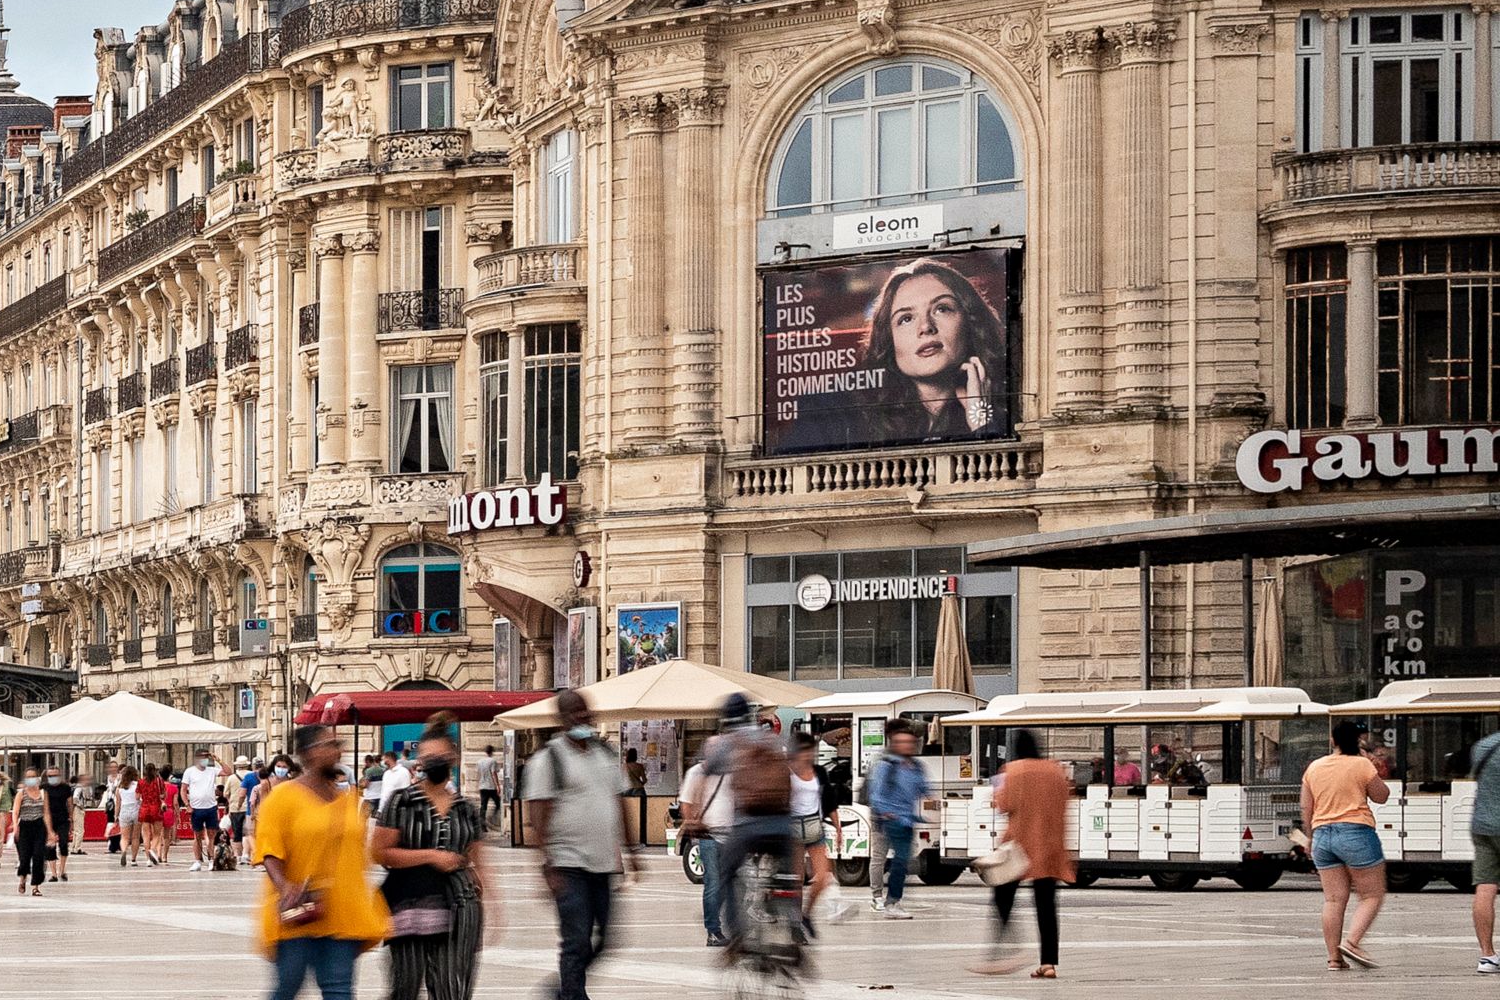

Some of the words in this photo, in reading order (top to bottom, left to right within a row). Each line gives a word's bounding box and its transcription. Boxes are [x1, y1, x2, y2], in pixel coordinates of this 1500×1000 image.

[857, 215, 919, 234] eleom
[857, 231, 918, 245] avocats
[776, 283, 803, 305] LES
[776, 305, 815, 328] PLUS
[776, 327, 832, 352] BELLES
[776, 348, 857, 375] HISTOIRES
[776, 368, 886, 398] COMMENCENT
[776, 400, 798, 421] ICI
[448, 472, 564, 534] mont
[835, 575, 948, 602] INDEPENDENCE
[384, 609, 453, 636] CIC
